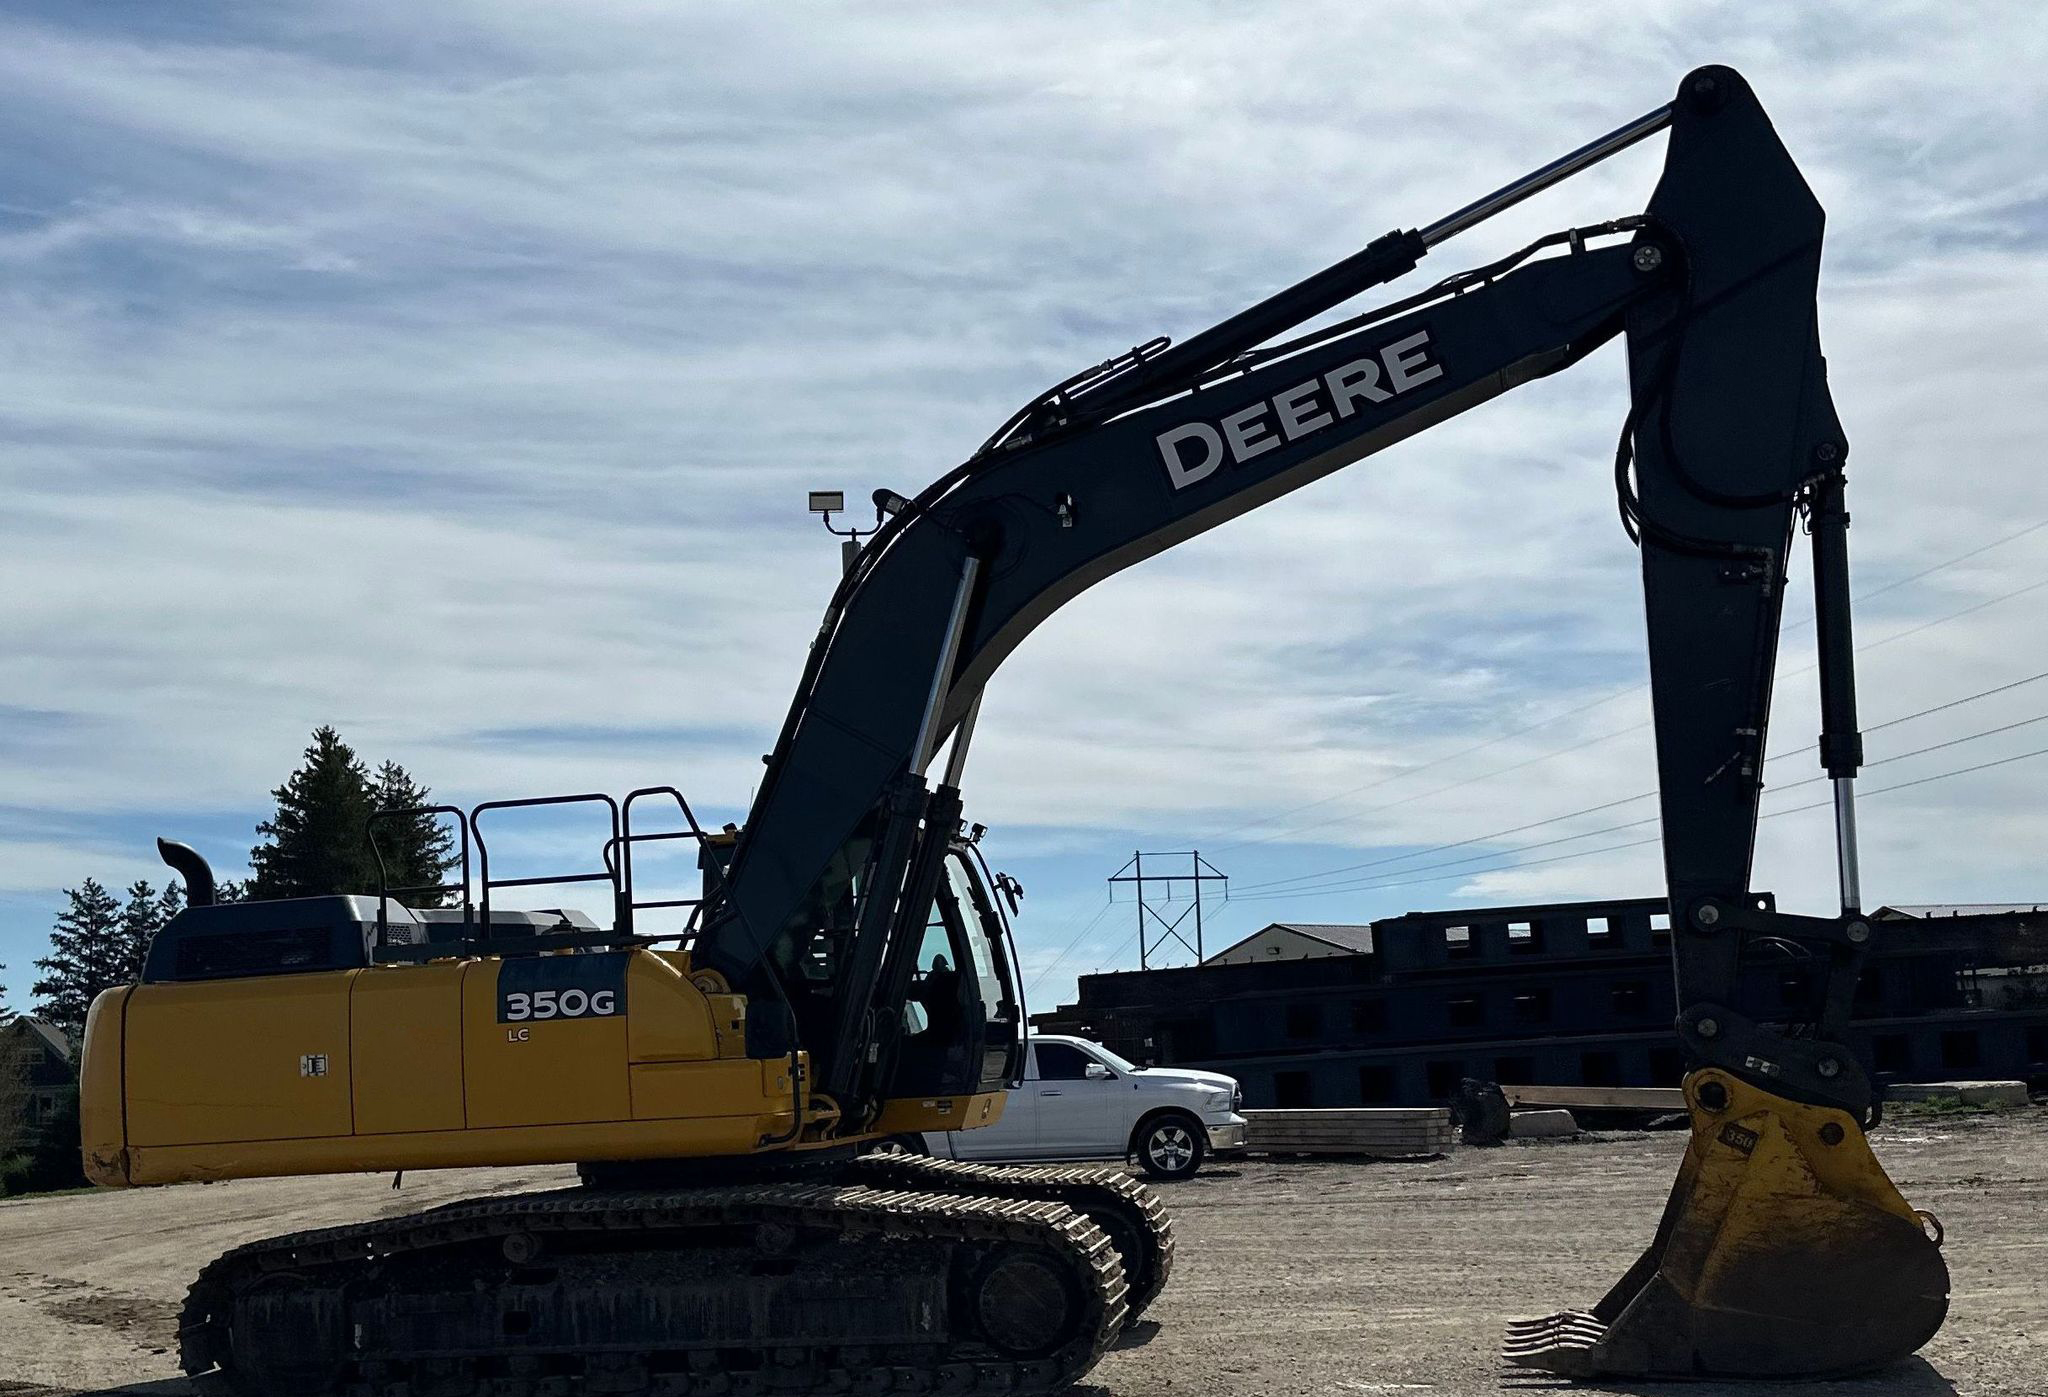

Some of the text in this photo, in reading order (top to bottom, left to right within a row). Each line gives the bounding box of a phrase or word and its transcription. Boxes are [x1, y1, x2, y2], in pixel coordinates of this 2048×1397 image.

[1156, 329, 1443, 491] DEERE
[506, 988, 615, 1021] 350G
[508, 1028, 529, 1042] LC
